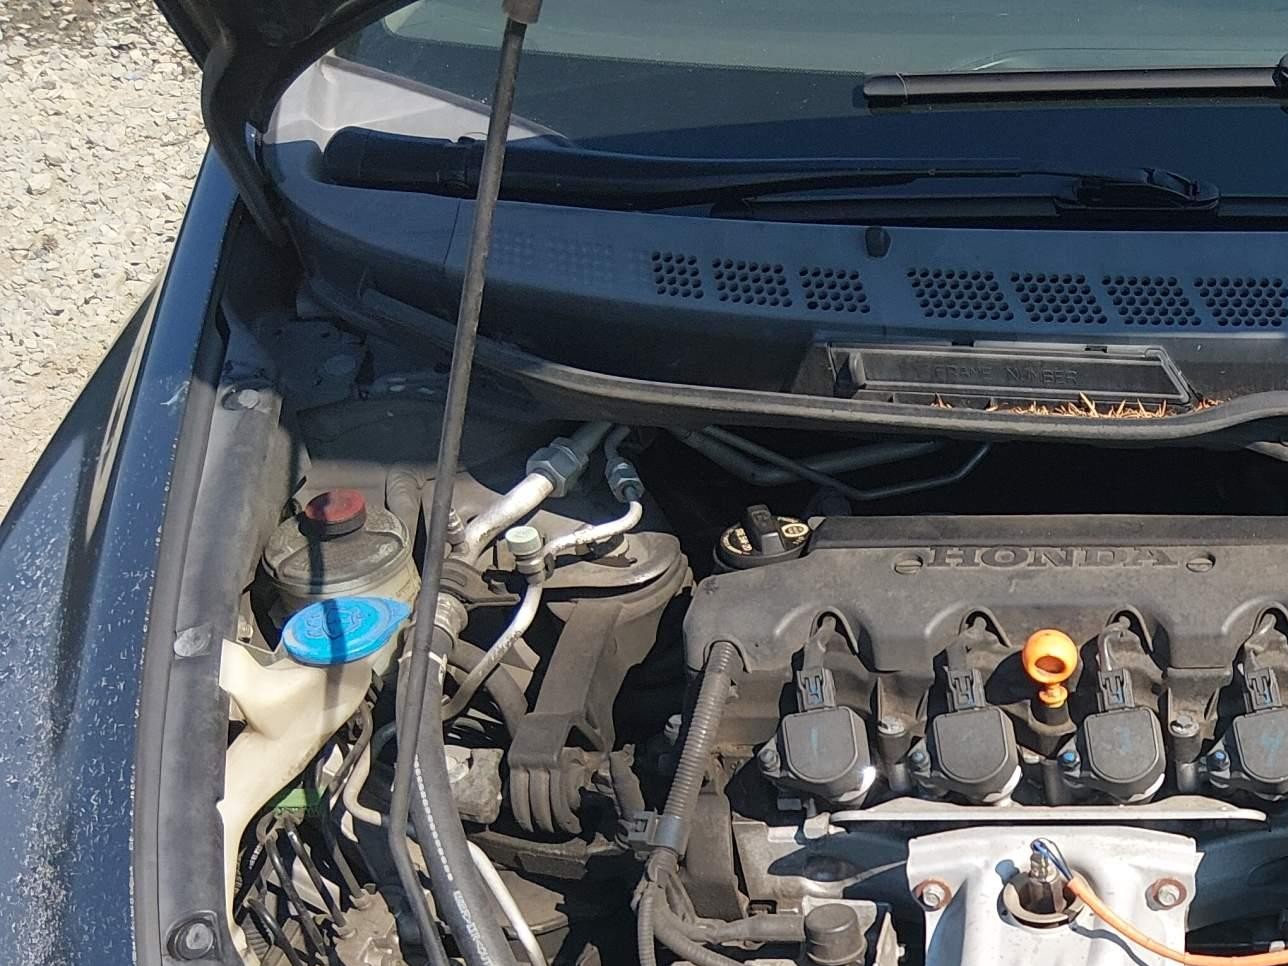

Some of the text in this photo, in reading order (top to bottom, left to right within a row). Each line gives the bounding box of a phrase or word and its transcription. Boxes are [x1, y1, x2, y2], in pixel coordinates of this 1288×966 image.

[934, 363, 1078, 386] FRAME NUMBER
[927, 544, 1179, 569] HONDA
